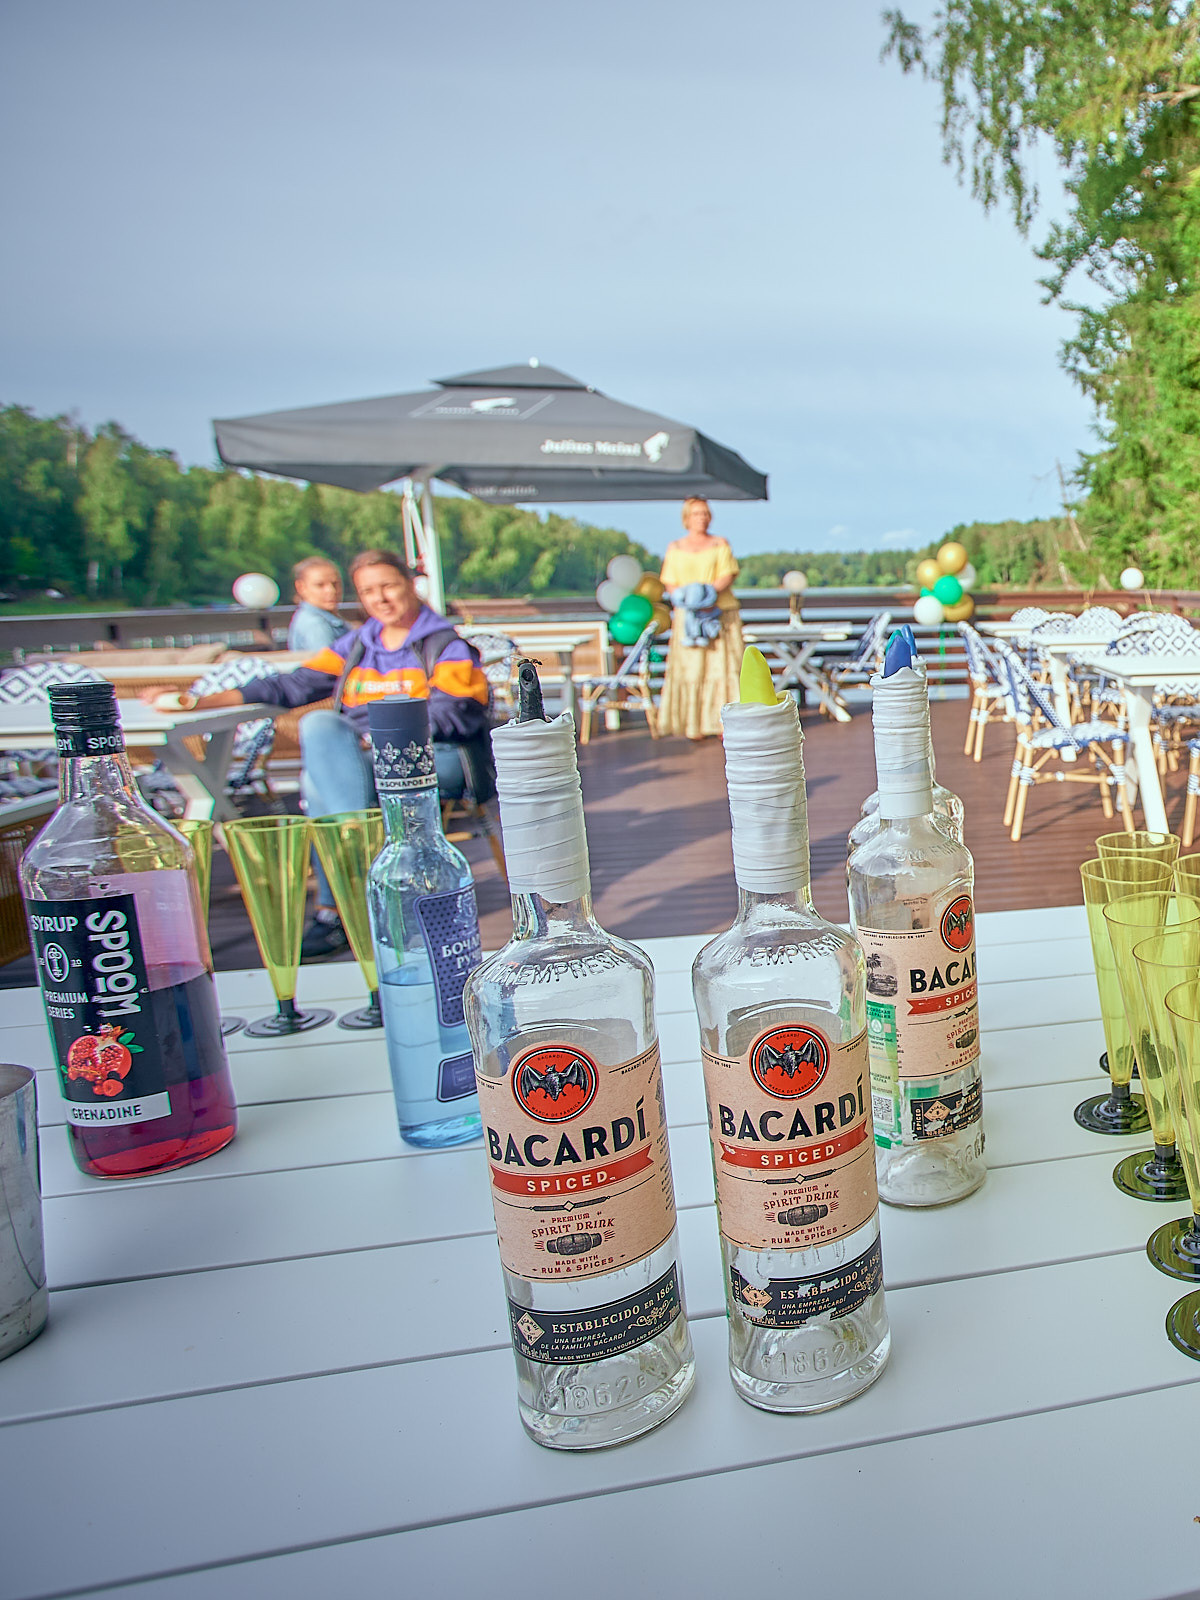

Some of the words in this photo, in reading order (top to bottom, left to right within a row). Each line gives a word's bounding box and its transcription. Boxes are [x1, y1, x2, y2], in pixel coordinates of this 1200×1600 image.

[30, 914, 79, 932] SYRUP
[45, 990, 89, 1004] PREMIUM
[48, 1005, 76, 1019] SERIES
[72, 1104, 142, 1120] GRENADINE
[718, 1073, 864, 1142] BACARDÍ
[487, 1095, 646, 1167] BACARDÍ
[760, 1145, 834, 1166] SPICED
[526, 1171, 608, 1193] SPICED
[783, 1185, 818, 1196] PREMIUM
[763, 1195, 801, 1210] SPIRIT
[806, 1189, 839, 1202] DRINK
[551, 1213, 590, 1223] PREMIUM
[531, 1224, 571, 1239] SPIRIT
[576, 1217, 616, 1231] DRINK
[804, 1226, 838, 1241] SPICES
[807, 1225, 825, 1233] WITH
[576, 1256, 614, 1271] SPICES
[579, 1254, 599, 1263] WITH
[552, 1304, 640, 1334] ESTABLECIDO
[656, 1280, 674, 1301] 1862
[788, 1306, 816, 1315] FAMILIA
[798, 1298, 830, 1309] EMPRESA
[571, 1332, 606, 1343] EMPRESA
[561, 1342, 591, 1350] FAMILIA
